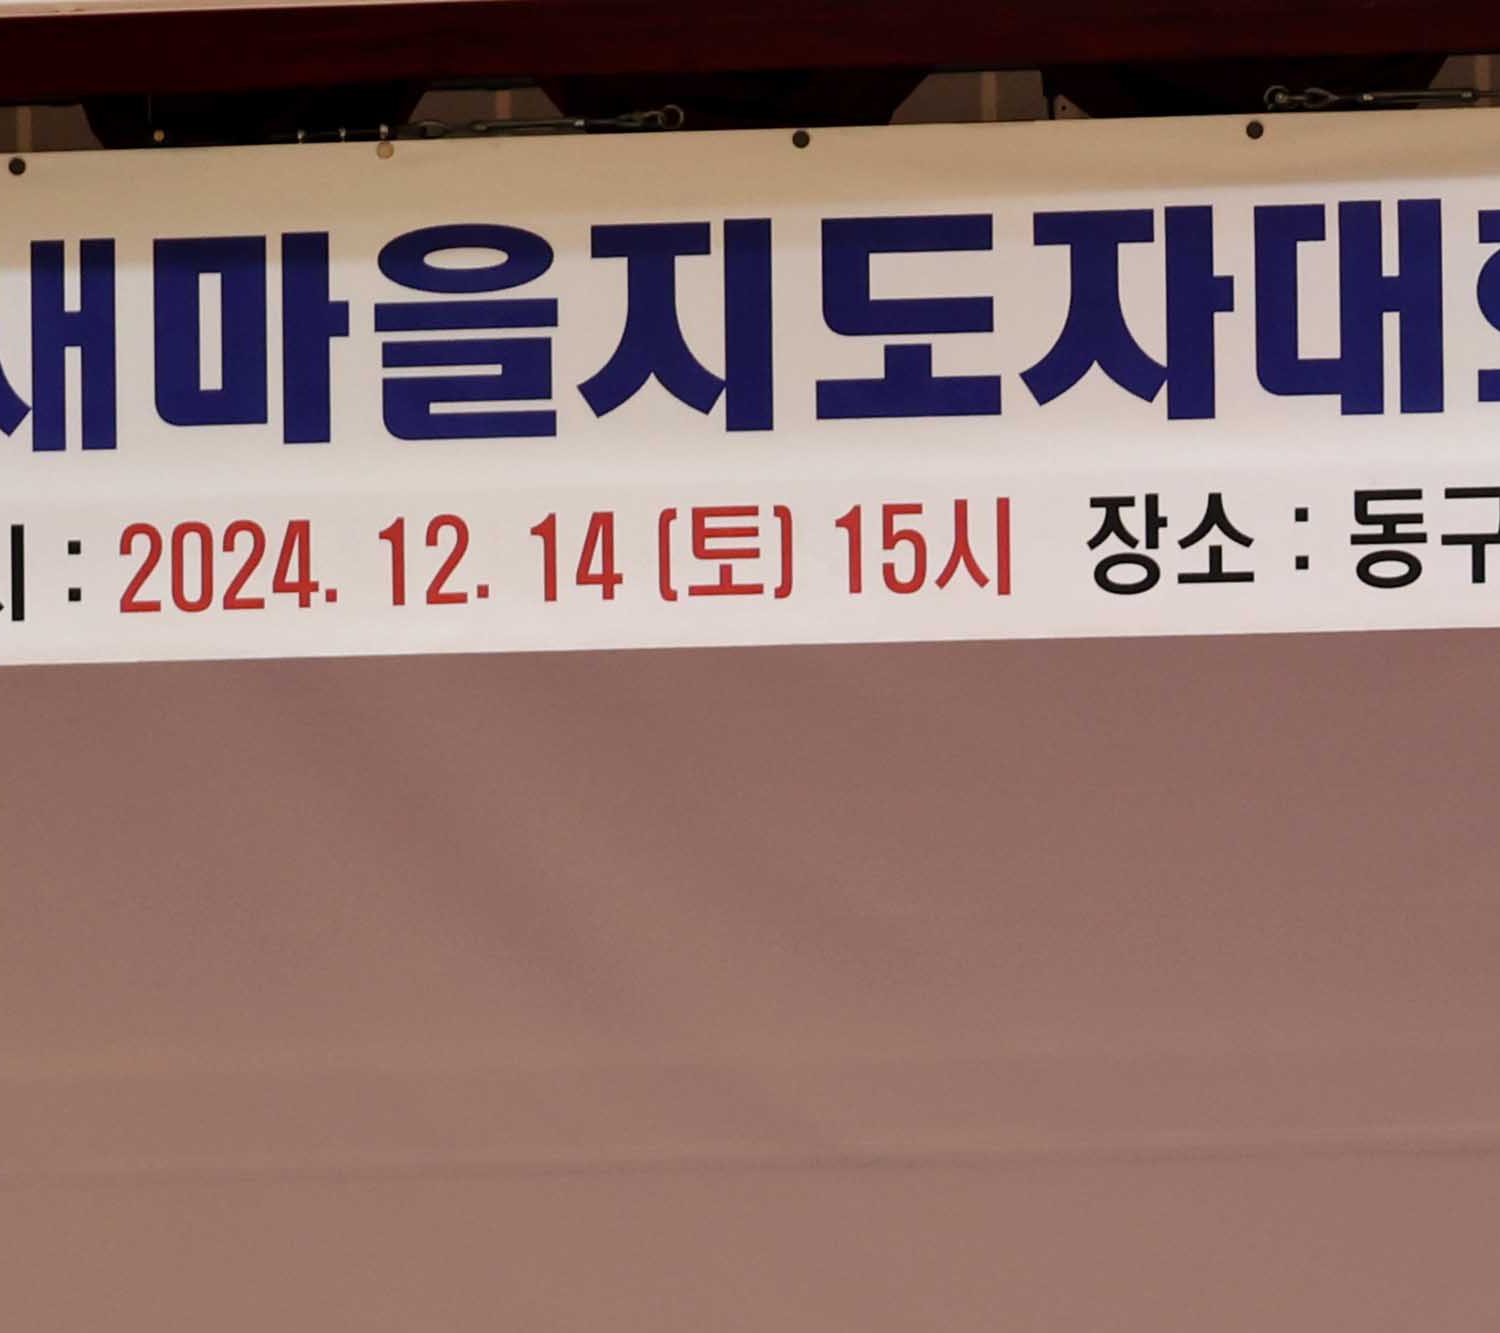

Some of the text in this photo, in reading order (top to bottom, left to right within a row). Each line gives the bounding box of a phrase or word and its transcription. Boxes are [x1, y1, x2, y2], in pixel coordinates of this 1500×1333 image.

[118, 518, 339, 615] 2024.
[378, 512, 490, 607] 12.
[530, 510, 625, 604] 14
[834, 495, 1013, 599] 15시
[1086, 490, 1257, 596] 장소
